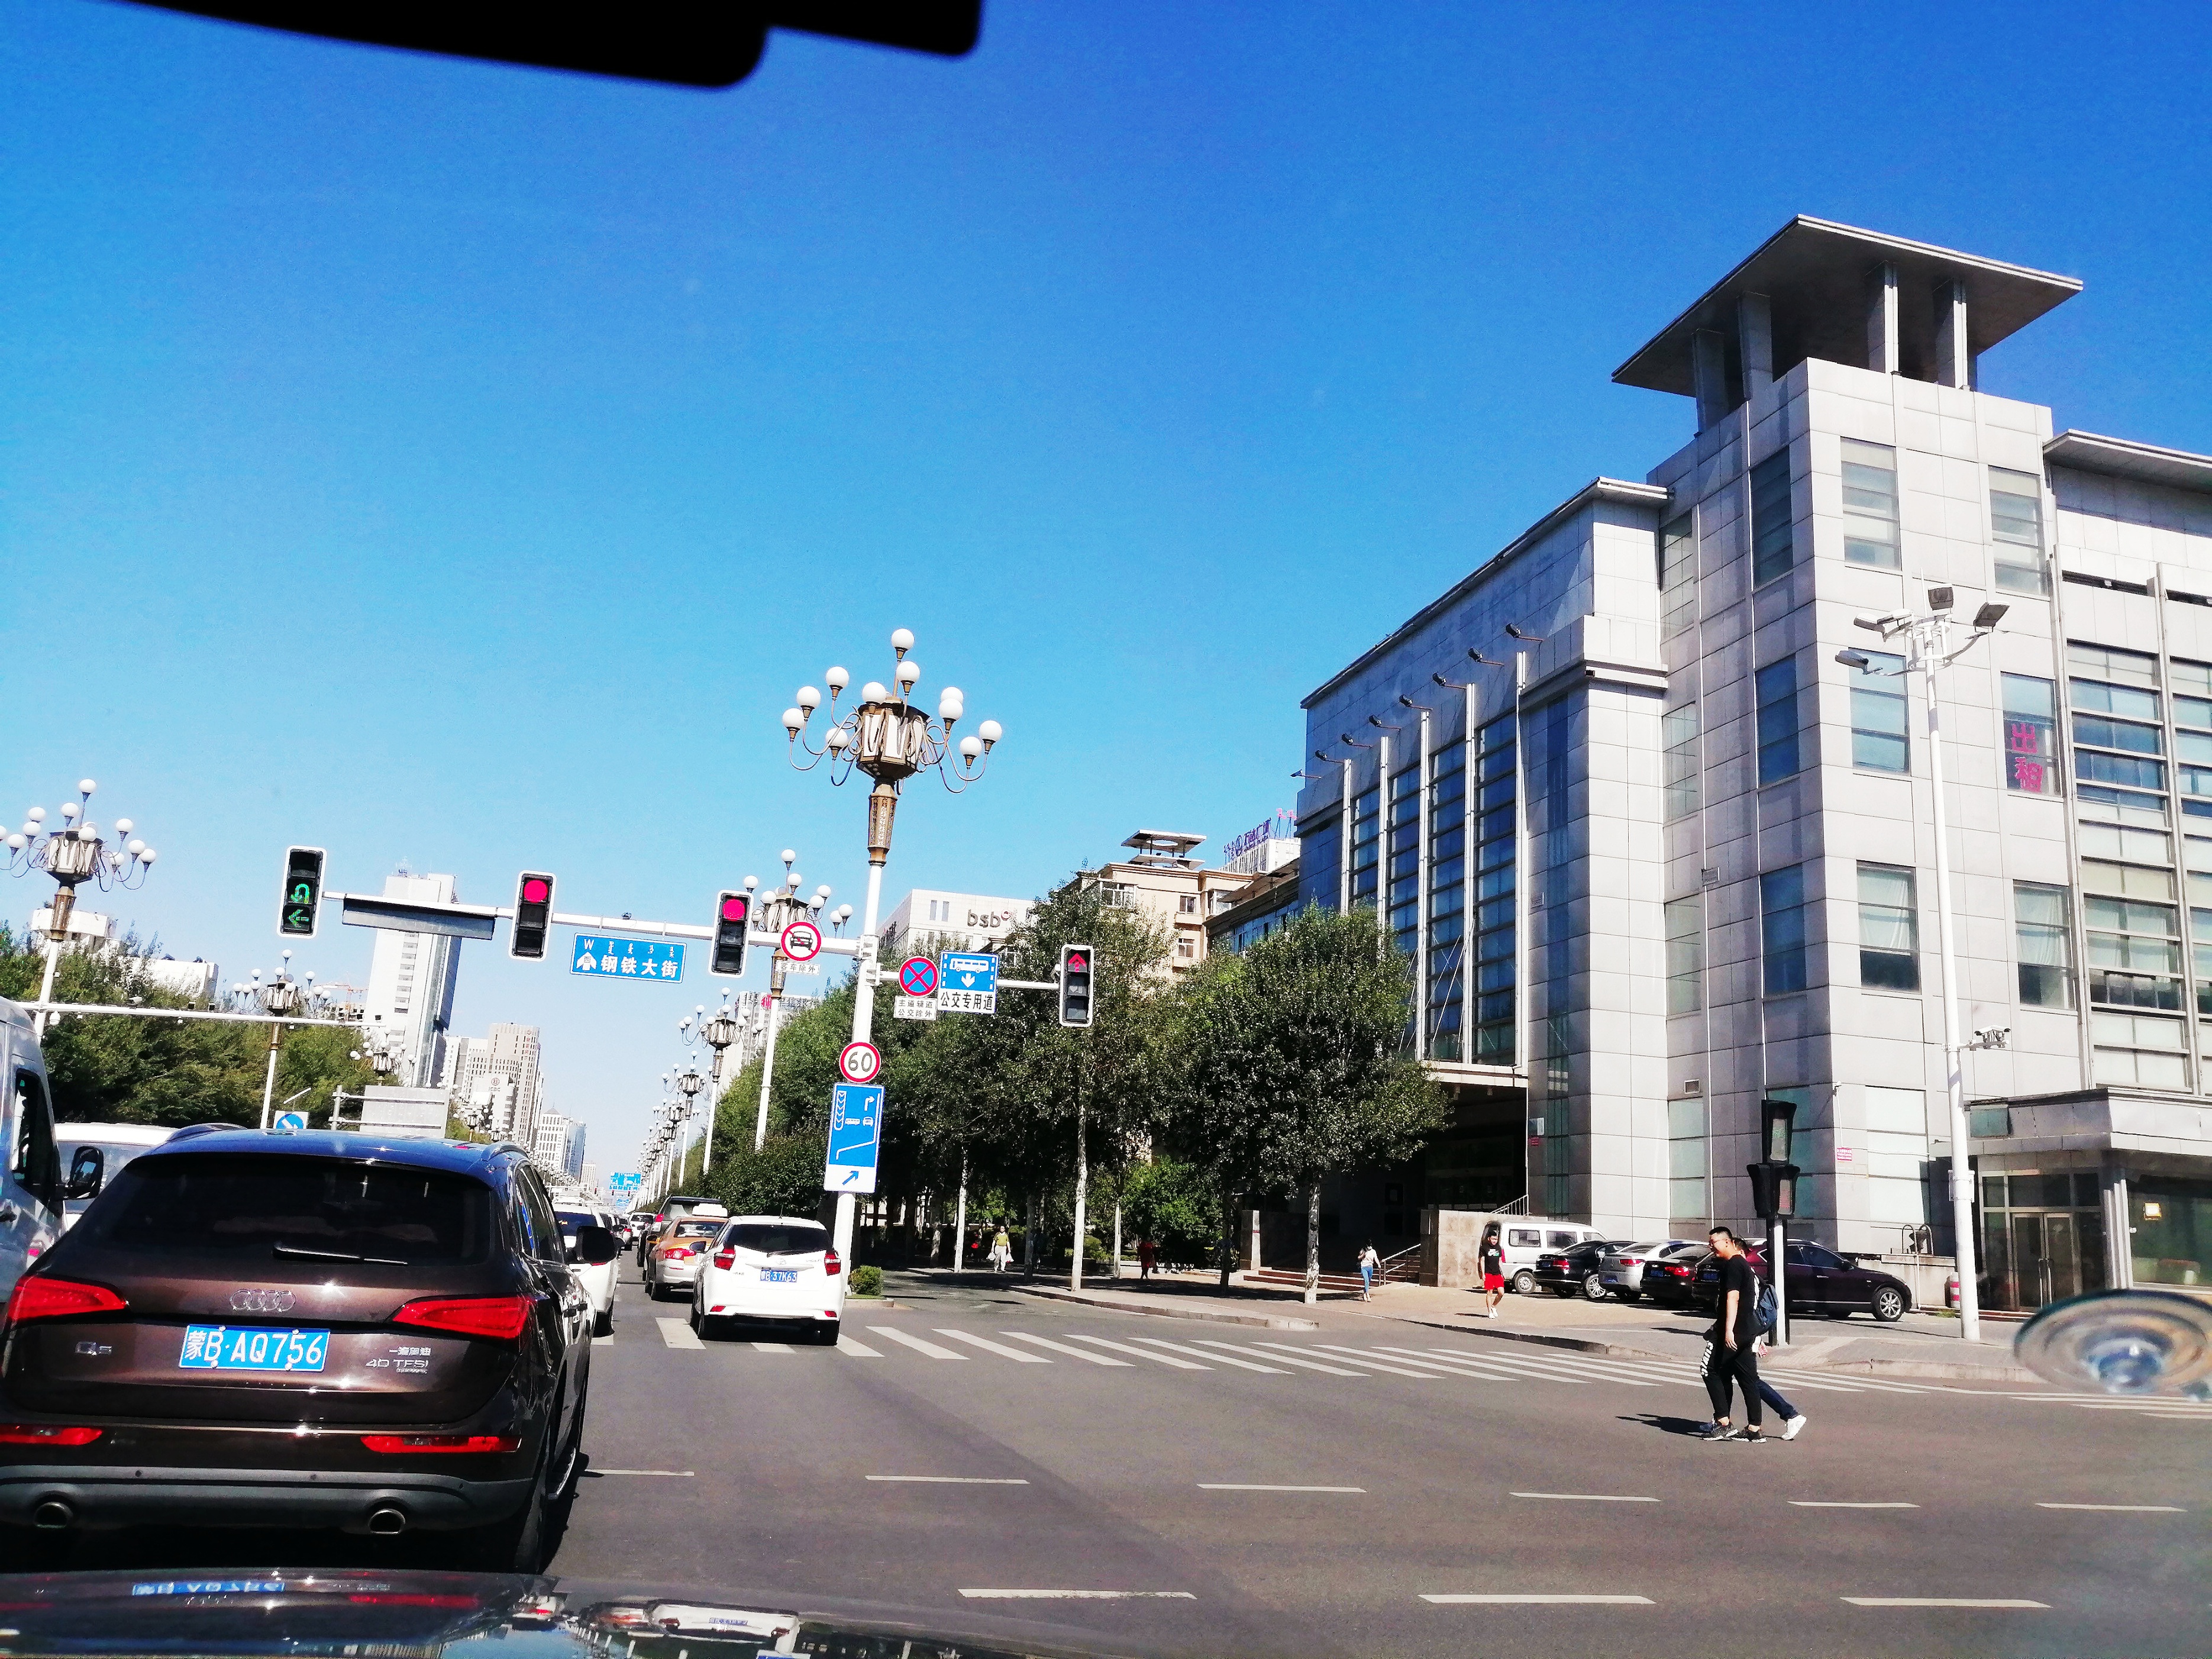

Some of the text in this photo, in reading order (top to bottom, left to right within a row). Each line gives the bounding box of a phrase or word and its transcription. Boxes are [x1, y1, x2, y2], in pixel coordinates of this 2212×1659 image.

[2011, 722, 2043, 793] 出租
[967, 909, 1001, 928] bsb
[584, 938, 594, 950] W
[600, 954, 678, 978] 钢铁大街
[940, 992, 993, 1011] 公交专用道
[898, 1009, 932, 1018] 公交除外
[848, 1051, 873, 1072] 60
[185, 1330, 323, 1364] 蒙B·AQ756
[393, 1359, 429, 1368] TFSI
